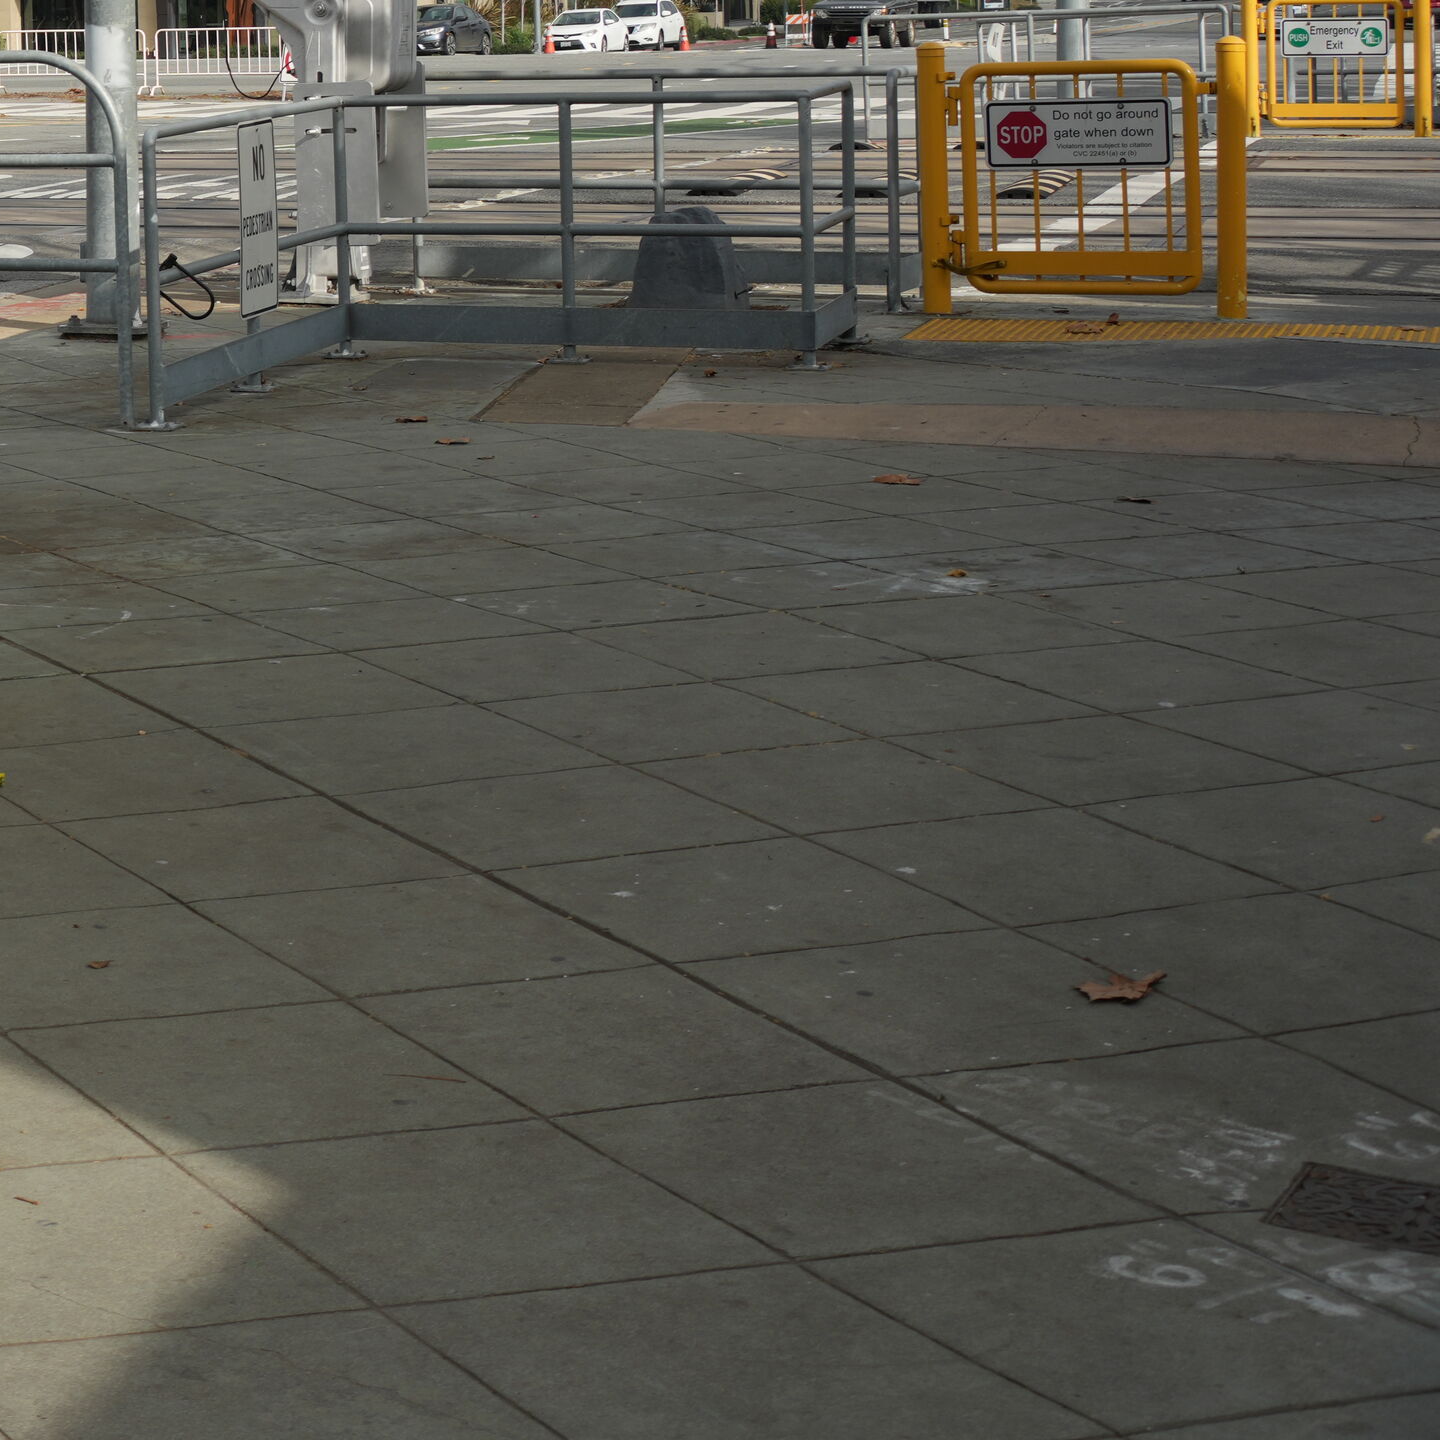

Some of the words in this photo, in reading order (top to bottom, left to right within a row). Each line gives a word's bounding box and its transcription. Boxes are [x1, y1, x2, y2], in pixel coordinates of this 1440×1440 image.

[1289, 33, 1308, 42] PUSH
[1310, 26, 1359, 37] Emergency
[1326, 40, 1343, 50] Exit
[1052, 110, 1070, 120] Do
[1074, 110, 1093, 120] not
[1097, 111, 1111, 121] go
[1116, 108, 1159, 119] around
[1000, 126, 1044, 144] STOP
[1054, 129, 1080, 140] gate
[1084, 128, 1117, 137] when
[1121, 127, 1154, 137] down
[1097, 142, 1120, 150] subject
[252, 143, 265, 182] NO
[243, 211, 273, 238] PEDESTRIAN
[246, 263, 274, 291] CROSSING
